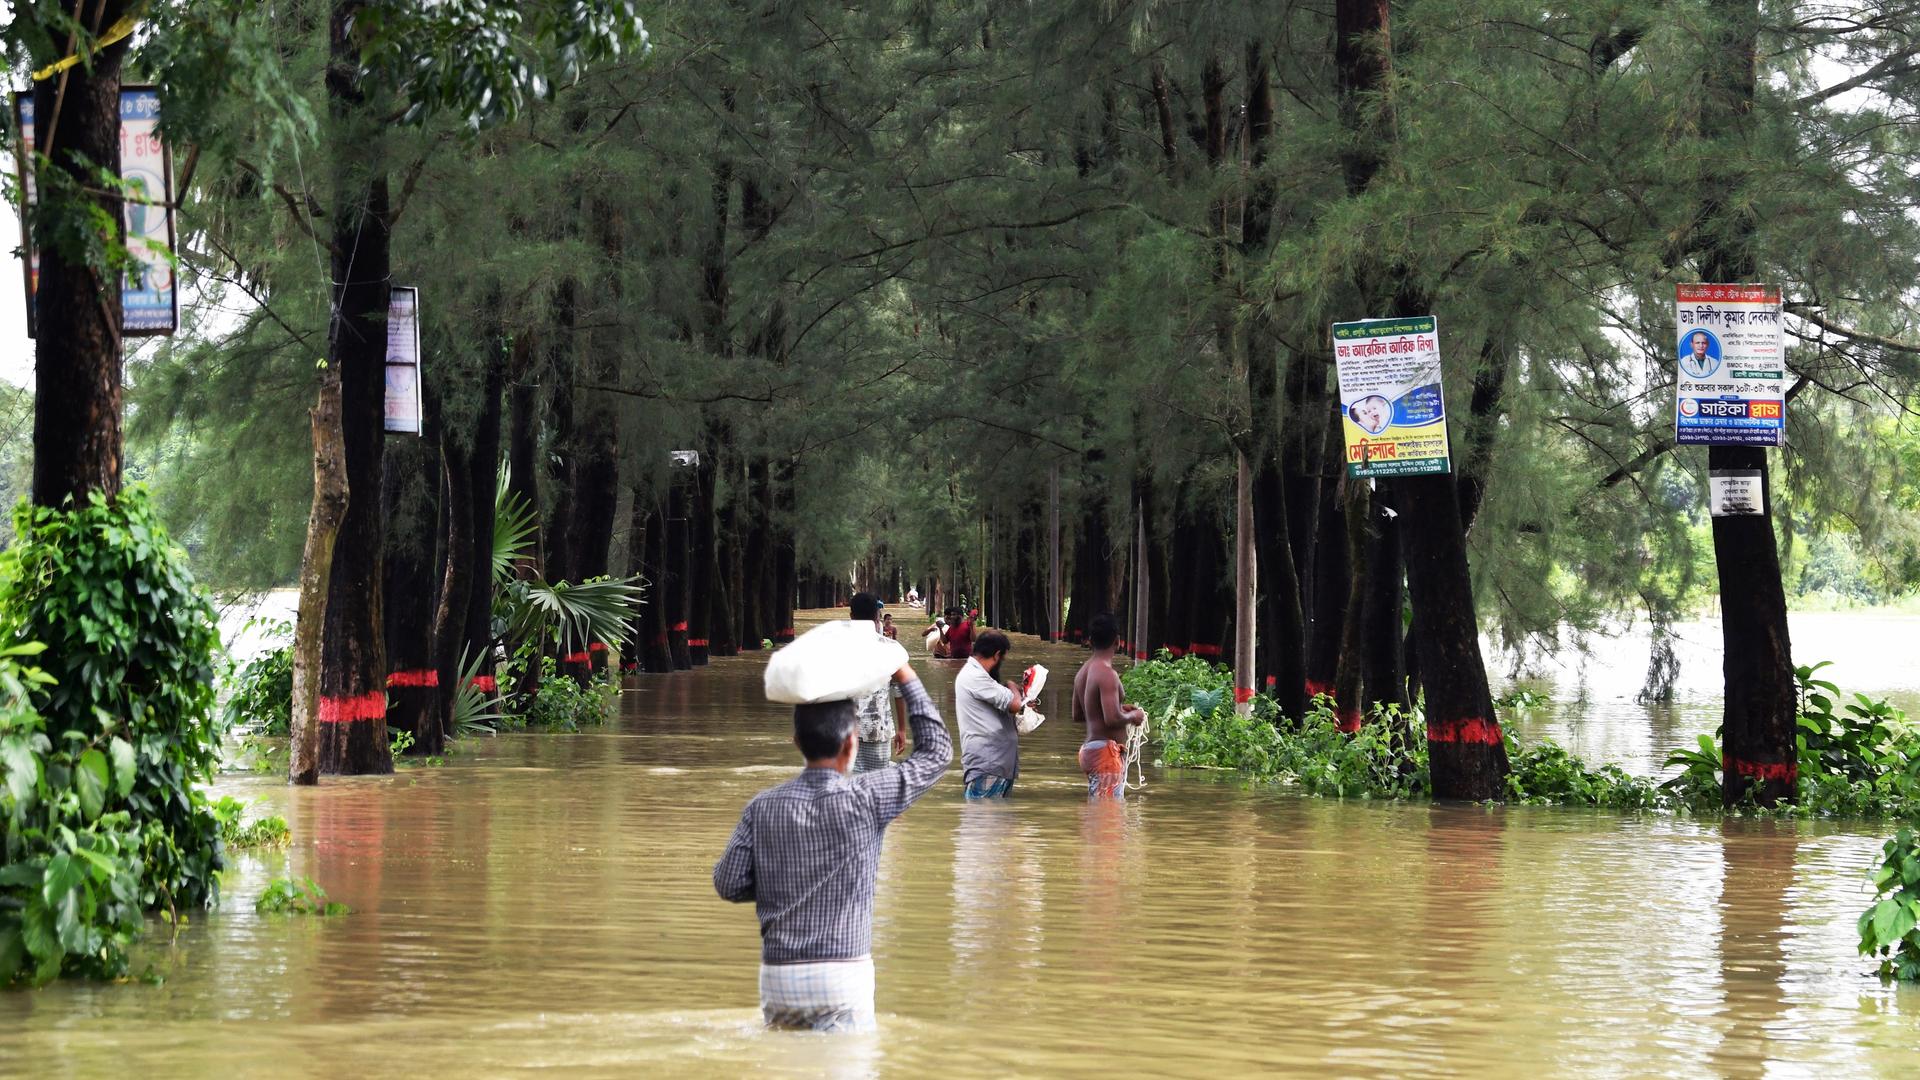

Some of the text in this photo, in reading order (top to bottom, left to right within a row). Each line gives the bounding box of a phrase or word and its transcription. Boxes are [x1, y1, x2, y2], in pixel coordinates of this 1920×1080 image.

[1680, 305, 1779, 329] ডাঃ দিলীপ কুমার দেবনাথ
[1337, 335, 1434, 357] ডাঃ আরেফিন আরিফ নিপা
[1679, 381, 1693, 392] প্রতি
[1695, 383, 1716, 393] শুক্রবার
[1717, 383, 1734, 392] সকাল
[1700, 400, 1780, 418] সাইকা প্লাস
